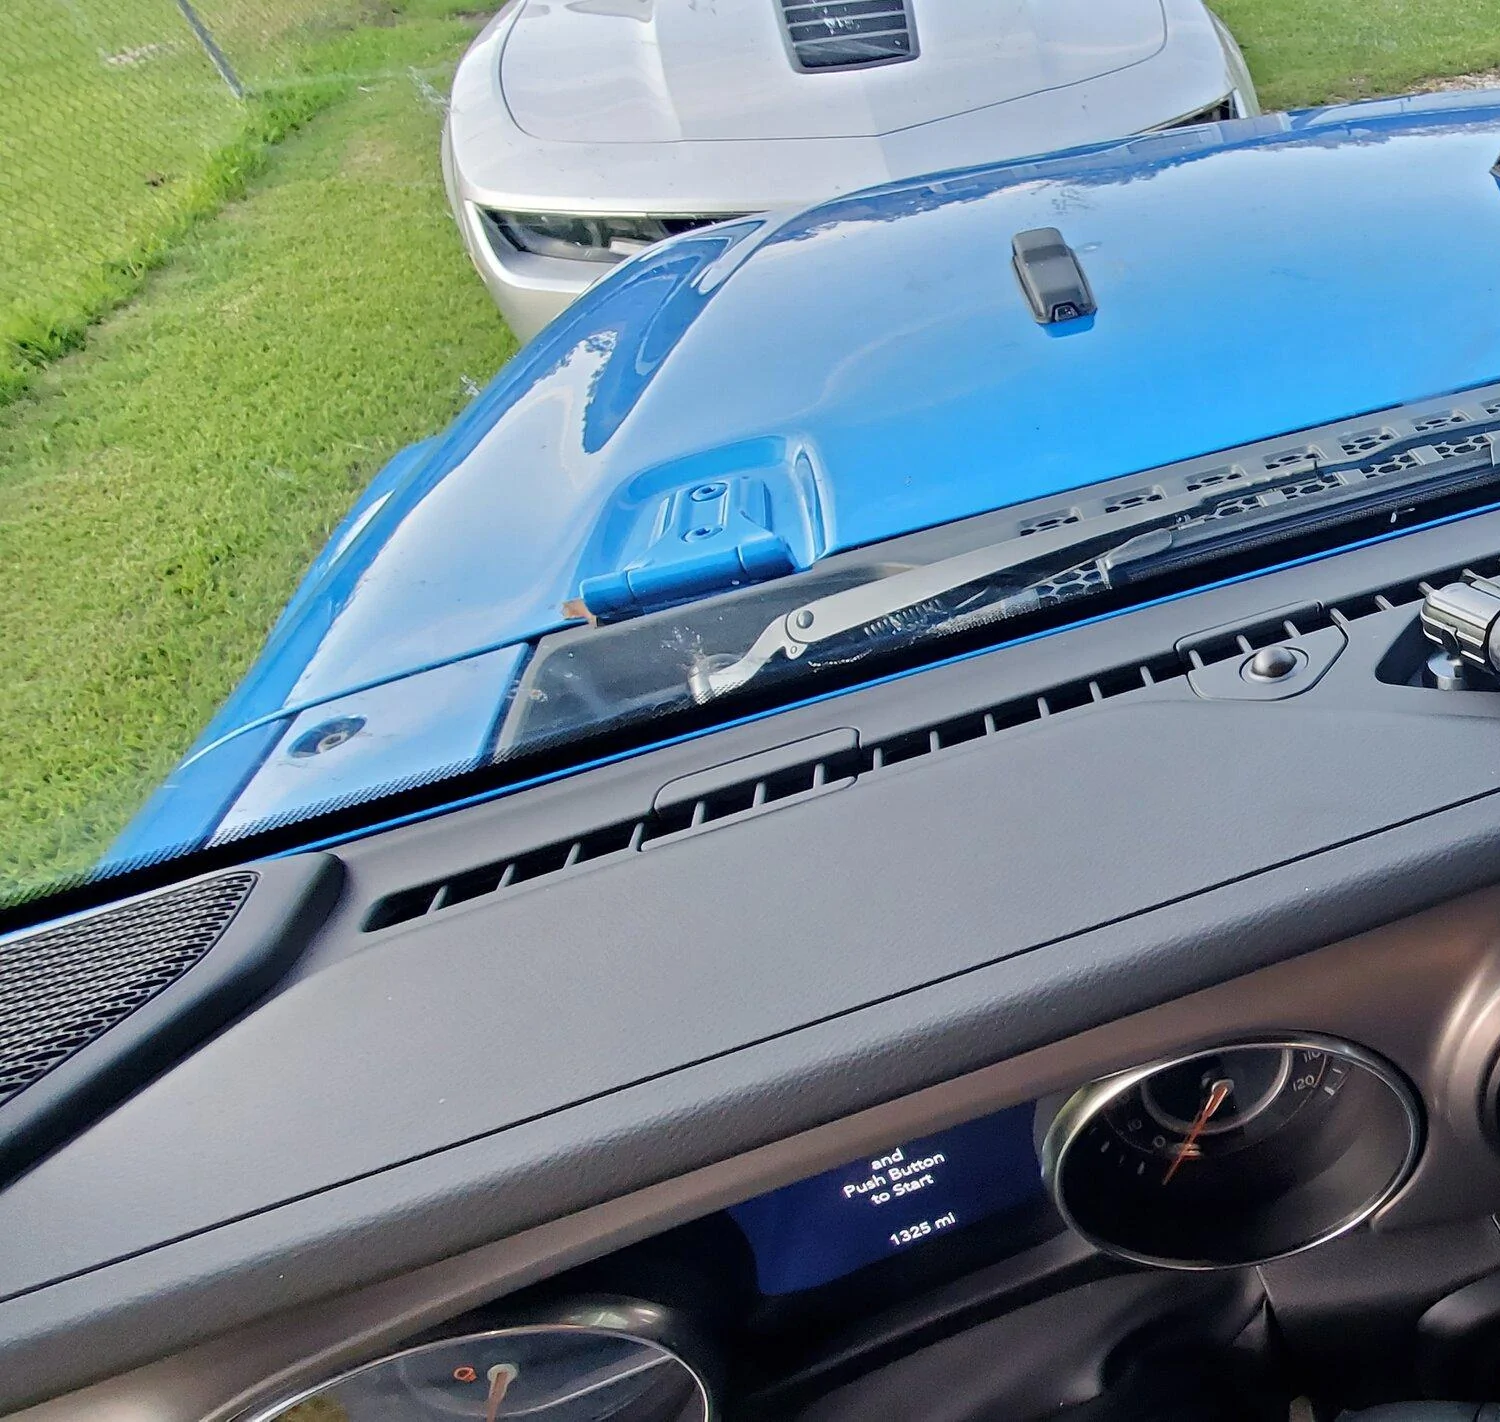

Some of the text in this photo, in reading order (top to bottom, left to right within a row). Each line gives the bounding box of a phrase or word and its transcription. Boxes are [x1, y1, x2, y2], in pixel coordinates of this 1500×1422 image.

[1292, 1074, 1315, 1092] 120
[870, 1147, 905, 1171] and
[843, 1152, 946, 1199] Push Button
[870, 1173, 935, 1205] to Start
[890, 1211, 957, 1246] 1325 mi
